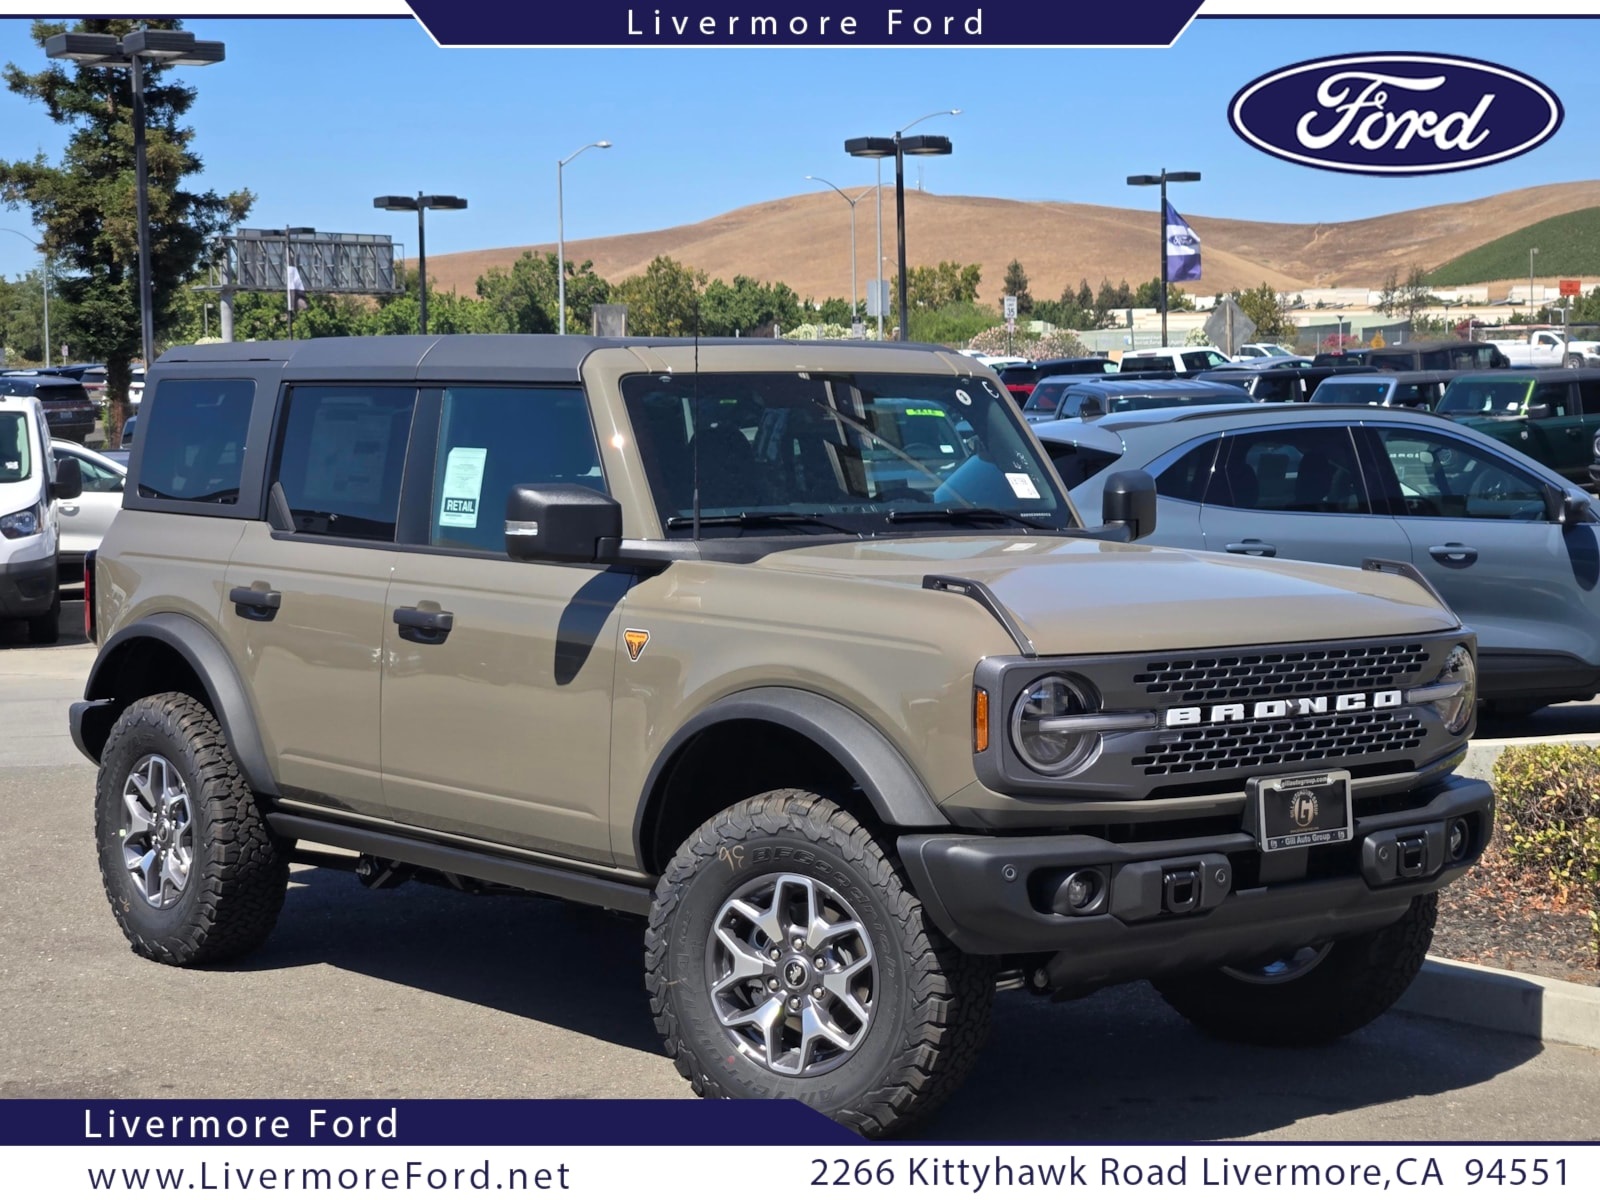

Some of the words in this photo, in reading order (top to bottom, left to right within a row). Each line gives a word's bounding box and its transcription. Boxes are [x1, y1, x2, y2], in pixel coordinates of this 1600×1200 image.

[1006, 307, 1016, 317] 35
[446, 499, 475, 513] RETAIL
[1166, 690, 1402, 727] BRONCO
[1285, 837, 1297, 846] Gill
[1297, 835, 1312, 845] Auto
[1312, 832, 1331, 842] Group
